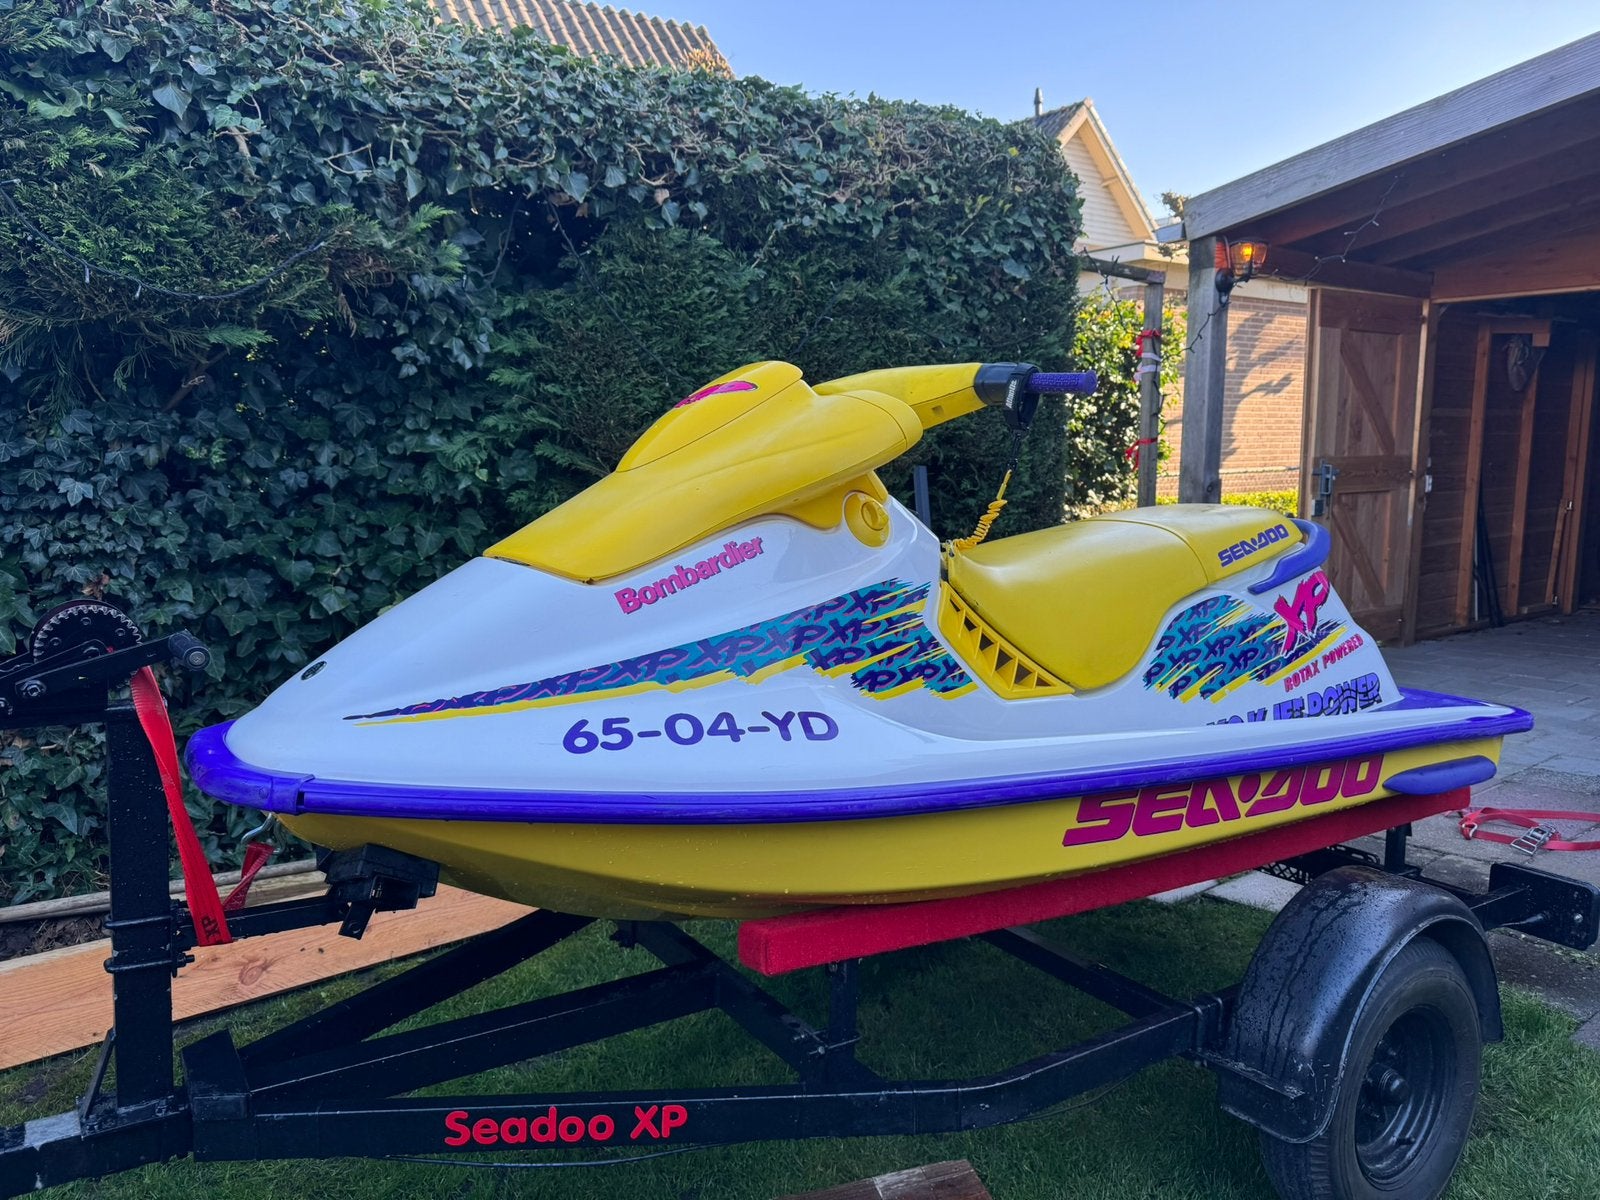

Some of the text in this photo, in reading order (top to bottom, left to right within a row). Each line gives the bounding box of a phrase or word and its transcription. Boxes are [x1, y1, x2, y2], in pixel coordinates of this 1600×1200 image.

[613, 535, 765, 614] Bombardier
[1274, 569, 1331, 655] XP
[1283, 633, 1364, 693] ROTAX POWERED
[1307, 672, 1382, 718] POWER
[562, 711, 839, 754] 65-04-YD
[444, 1104, 688, 1147] Seadoo XP
